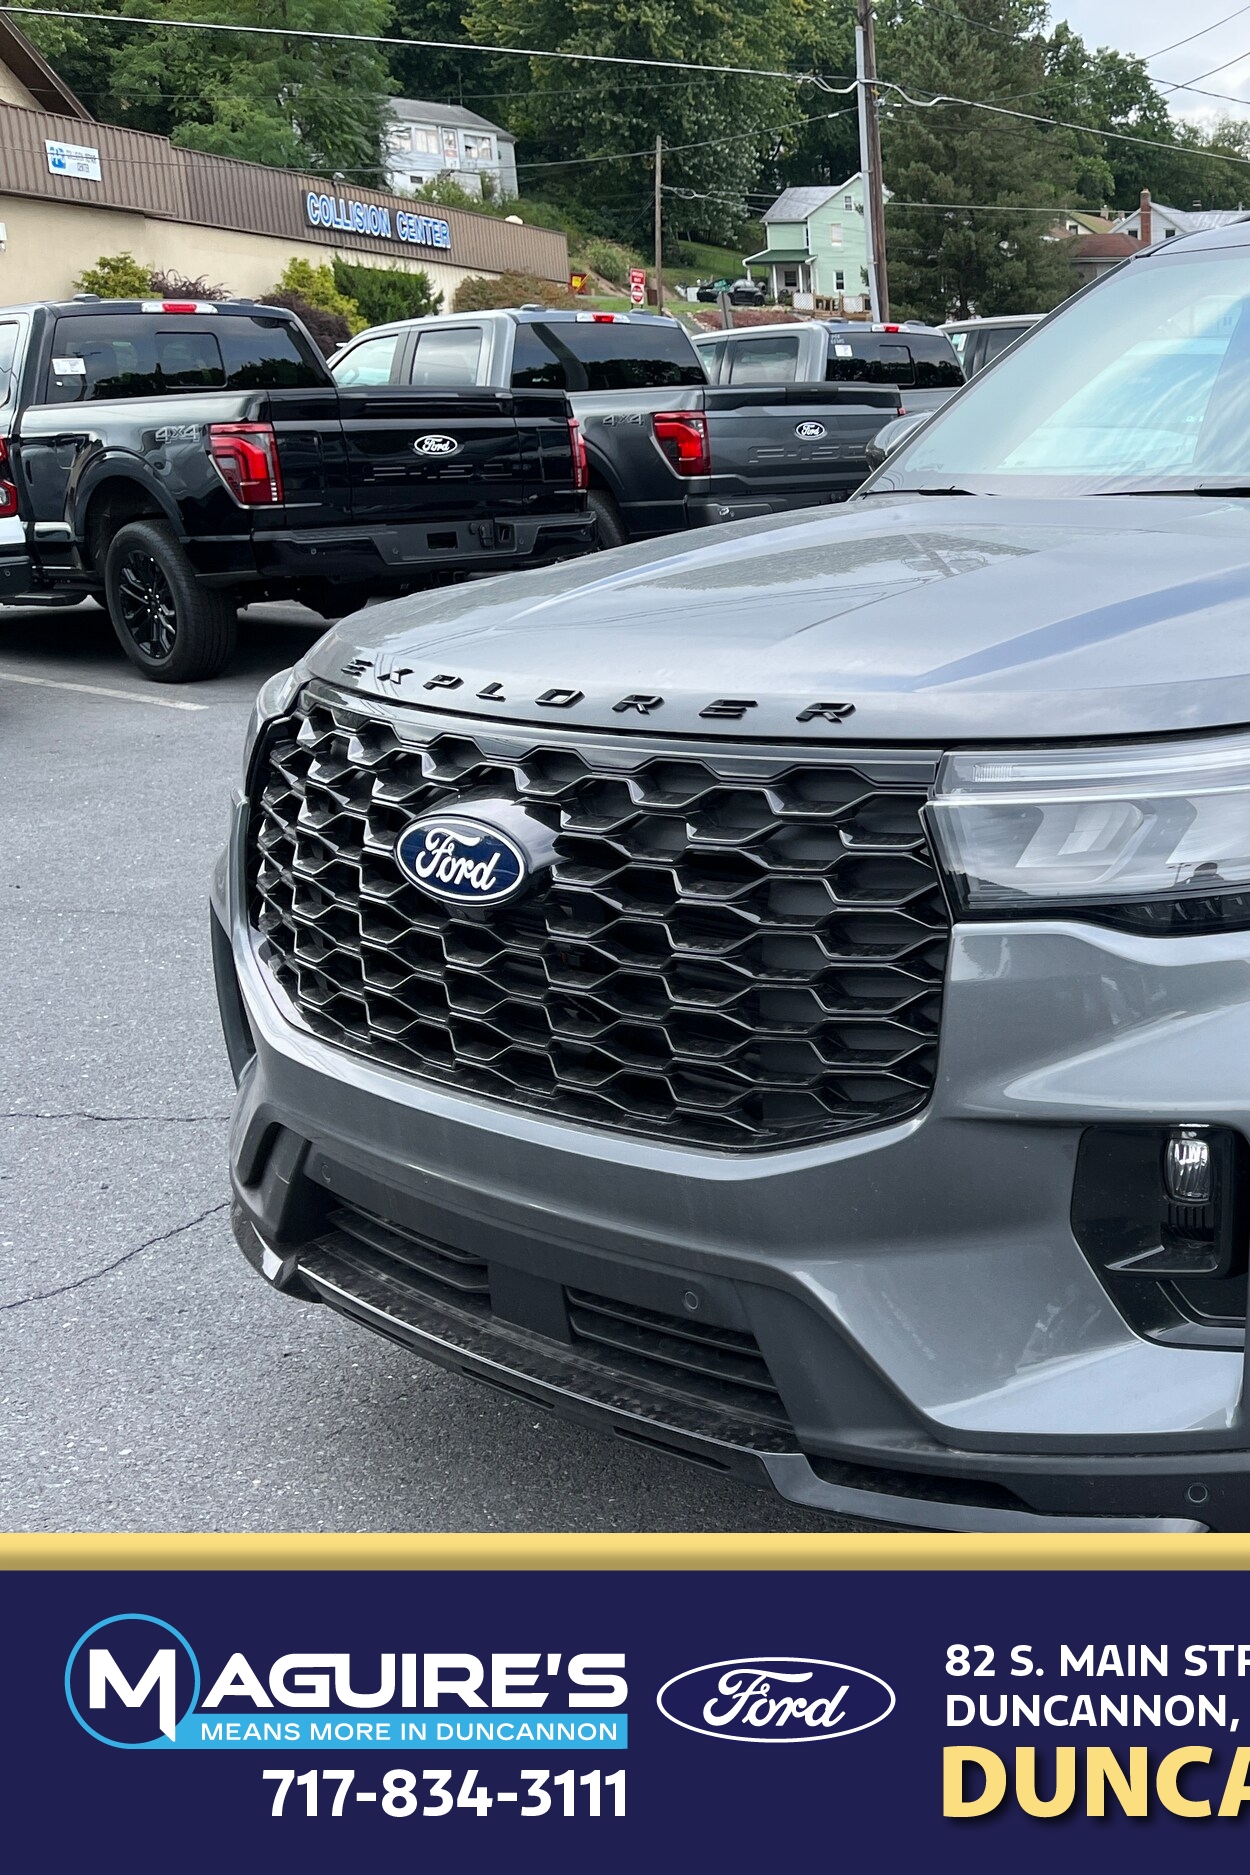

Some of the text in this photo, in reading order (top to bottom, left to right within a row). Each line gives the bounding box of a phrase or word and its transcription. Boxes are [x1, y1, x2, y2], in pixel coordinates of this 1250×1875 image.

[307, 191, 451, 249] COLLISION CENTER
[341, 658, 857, 723] EXPLORER
[414, 827, 500, 892] Ford
